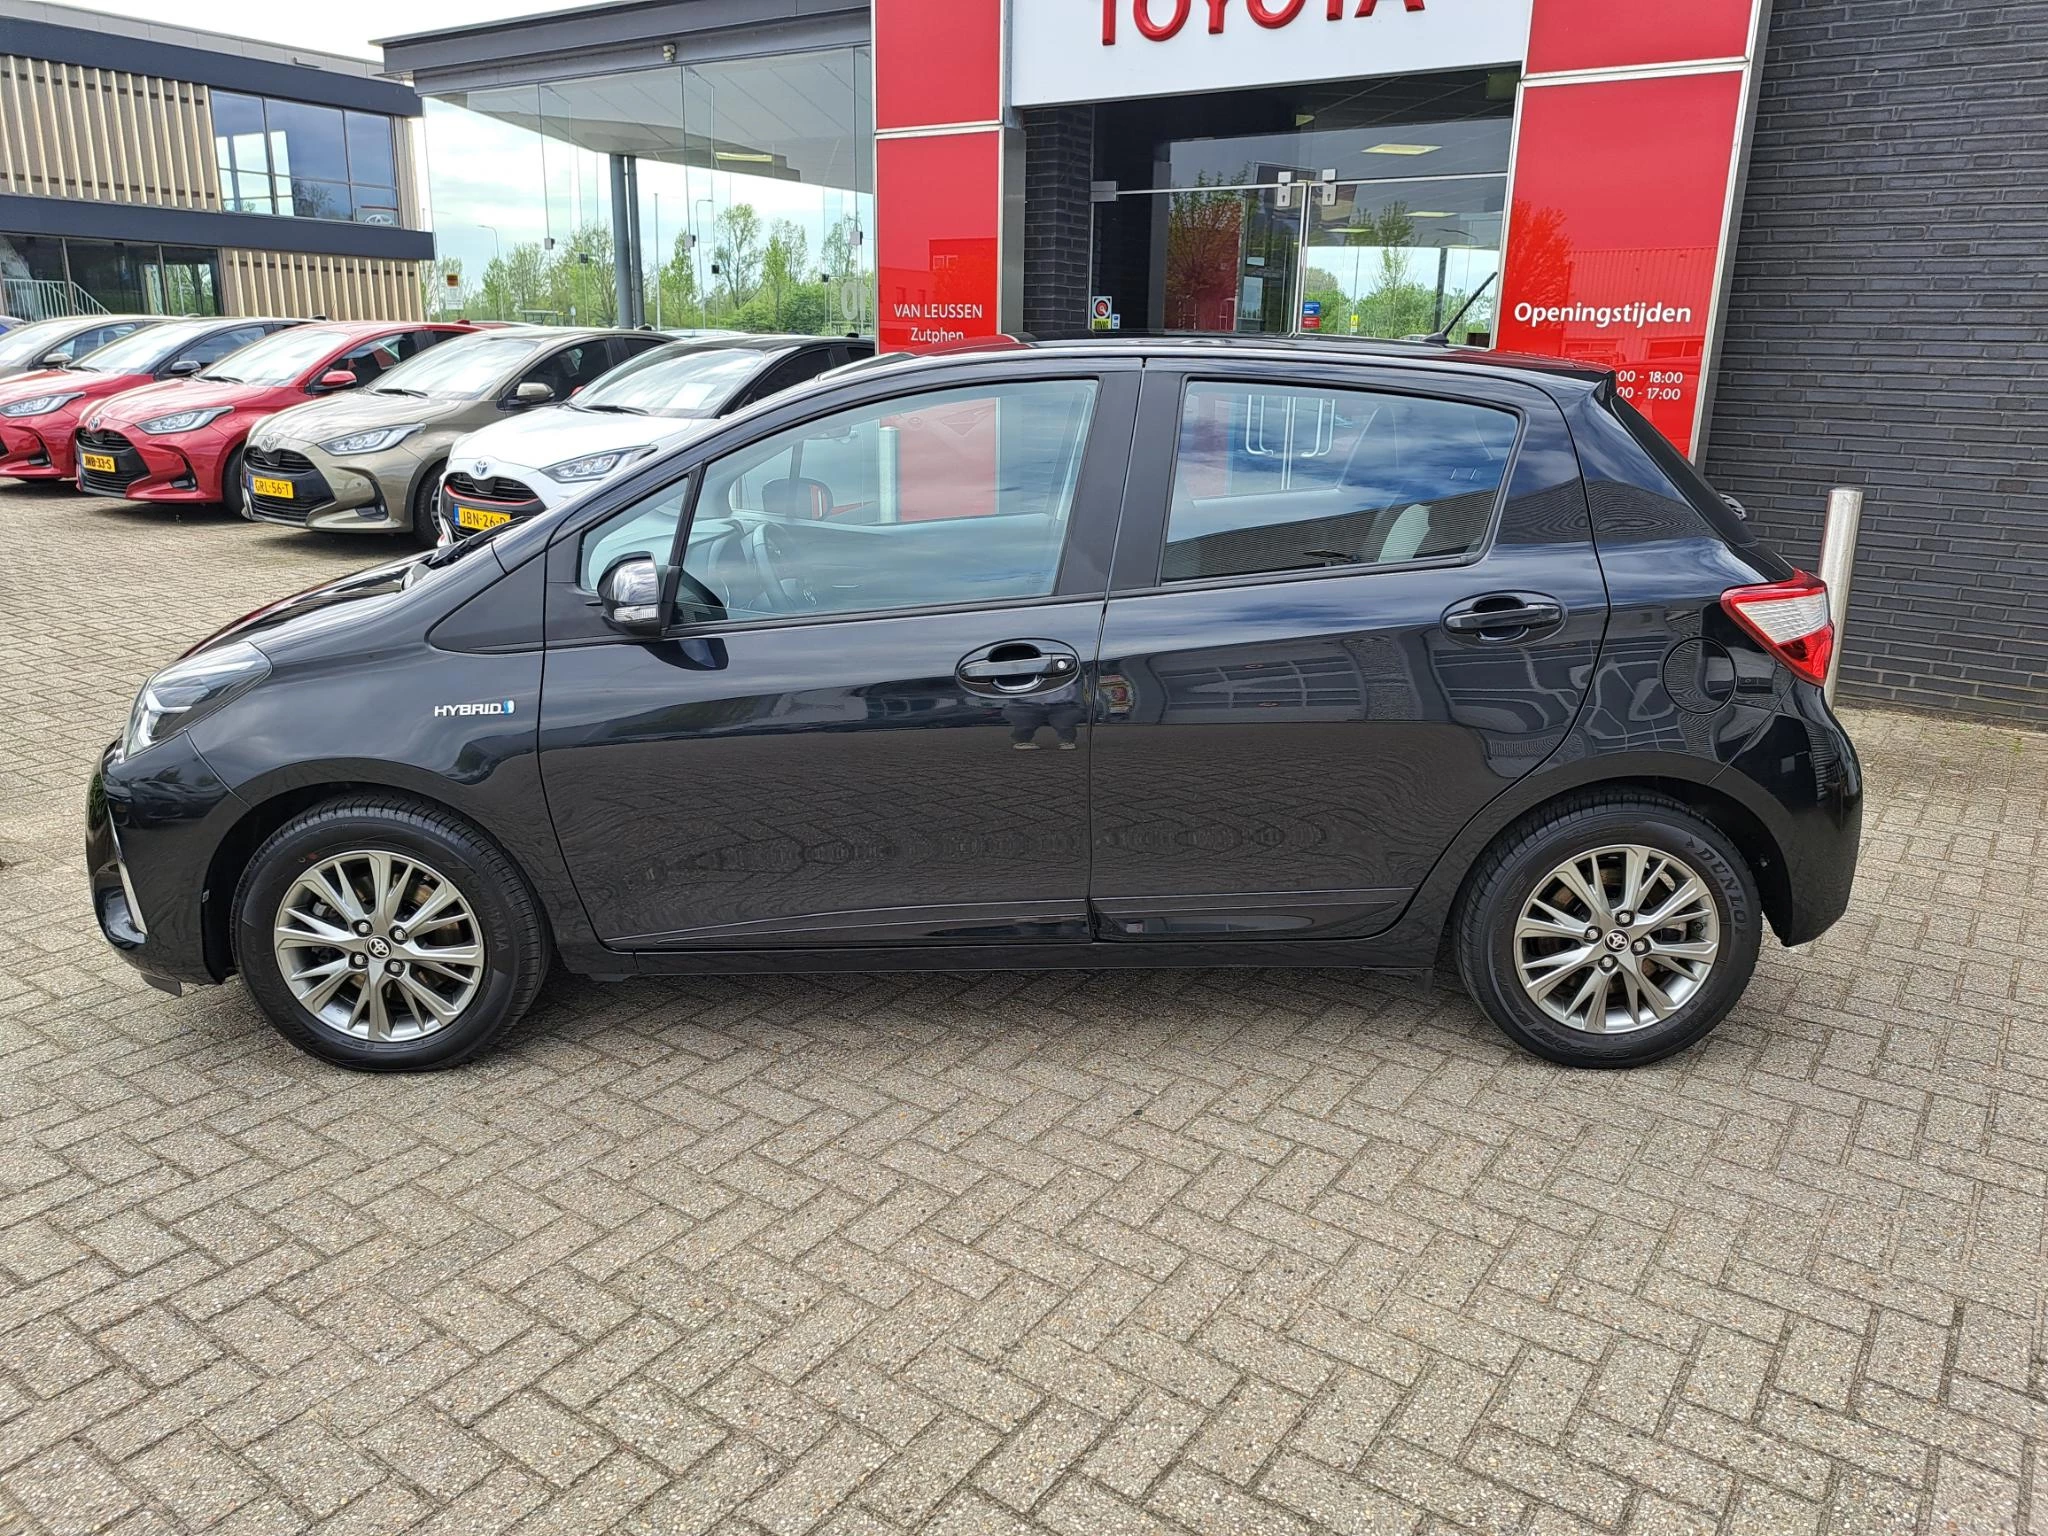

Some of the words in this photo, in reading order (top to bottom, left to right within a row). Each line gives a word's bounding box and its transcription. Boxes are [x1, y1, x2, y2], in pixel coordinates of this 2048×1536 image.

[1102, 0, 1425, 45] TOY
[894, 303, 920, 318] VAN
[924, 303, 983, 319] LEUSSEN
[1514, 302, 1691, 328] Openingstijden
[911, 327, 964, 344] Zutphen
[1649, 371, 1683, 384] 18:00
[1647, 387, 1681, 400] 17:00
[255, 480, 289, 495] GRL-56-T
[434, 703, 503, 717] HYBRID
